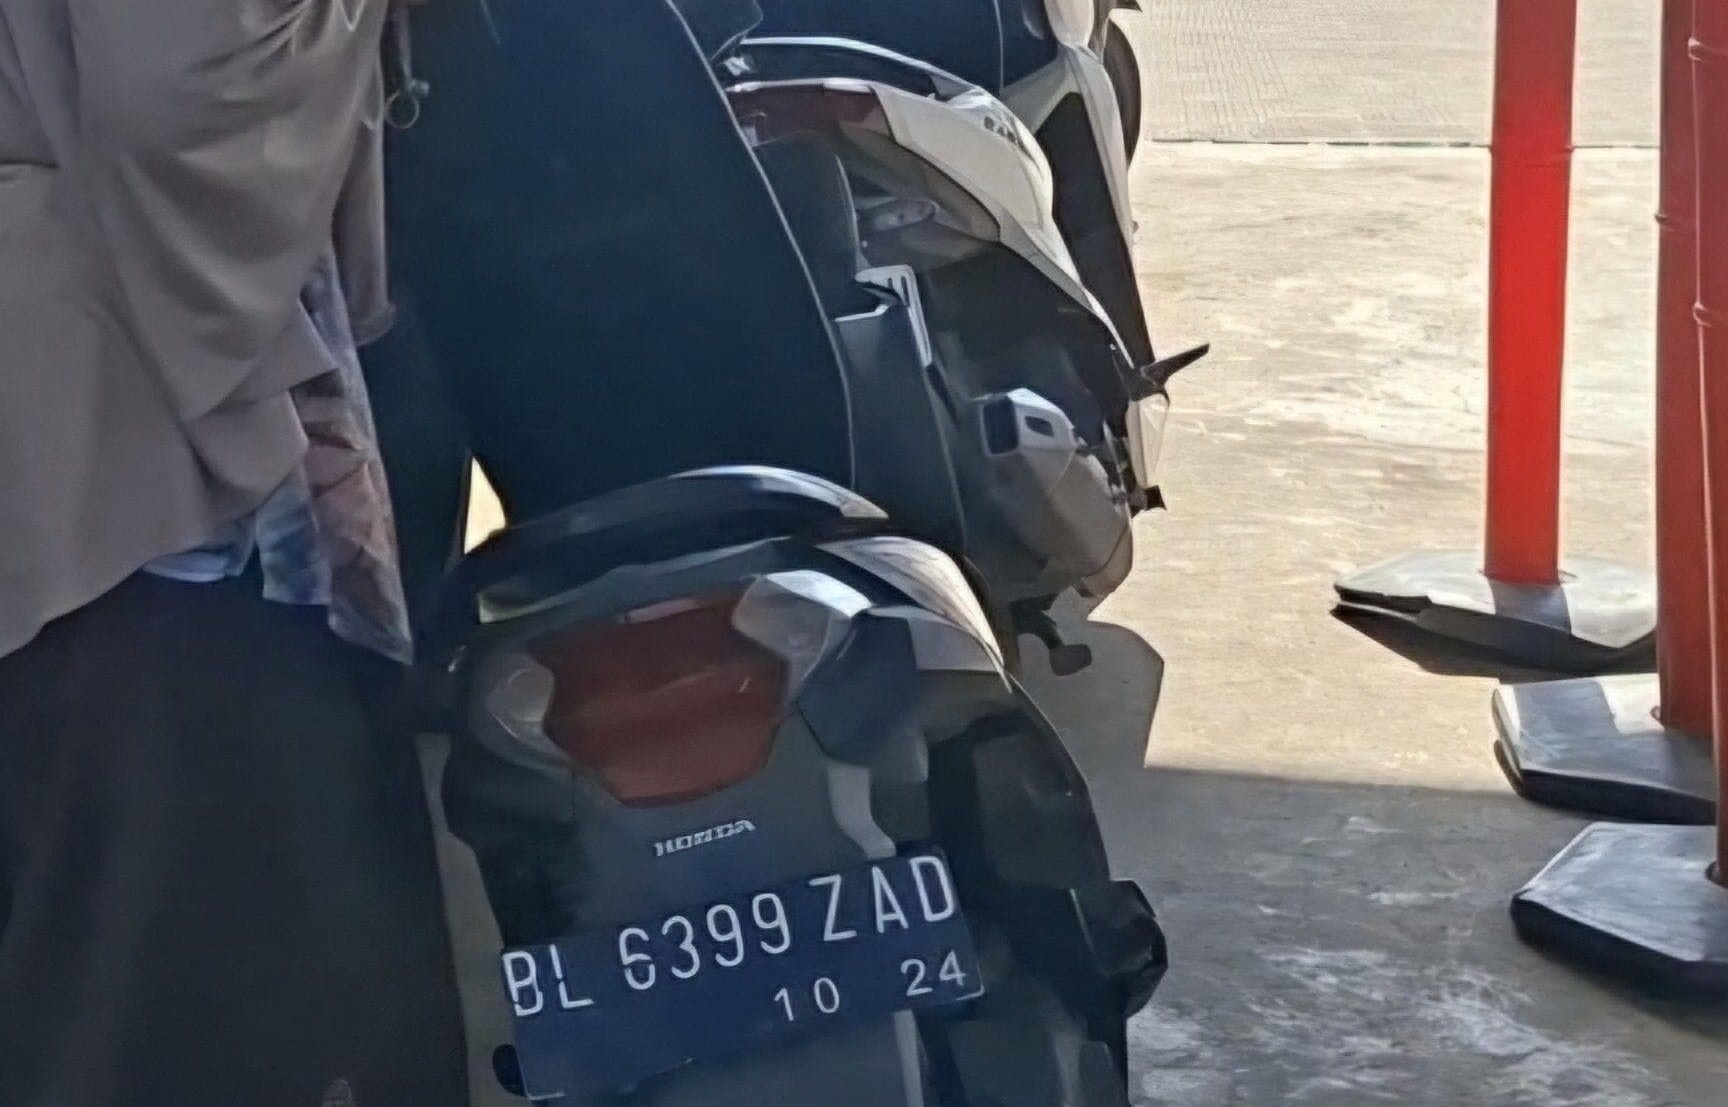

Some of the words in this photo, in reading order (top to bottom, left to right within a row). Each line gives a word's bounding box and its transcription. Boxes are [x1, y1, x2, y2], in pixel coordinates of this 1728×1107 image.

[654, 819, 756, 857] HONDA
[501, 943, 595, 1017] BL
[617, 892, 792, 991] 6399
[808, 854, 956, 943] ZAD
[773, 976, 841, 1022] 10
[899, 949, 968, 997] 24
